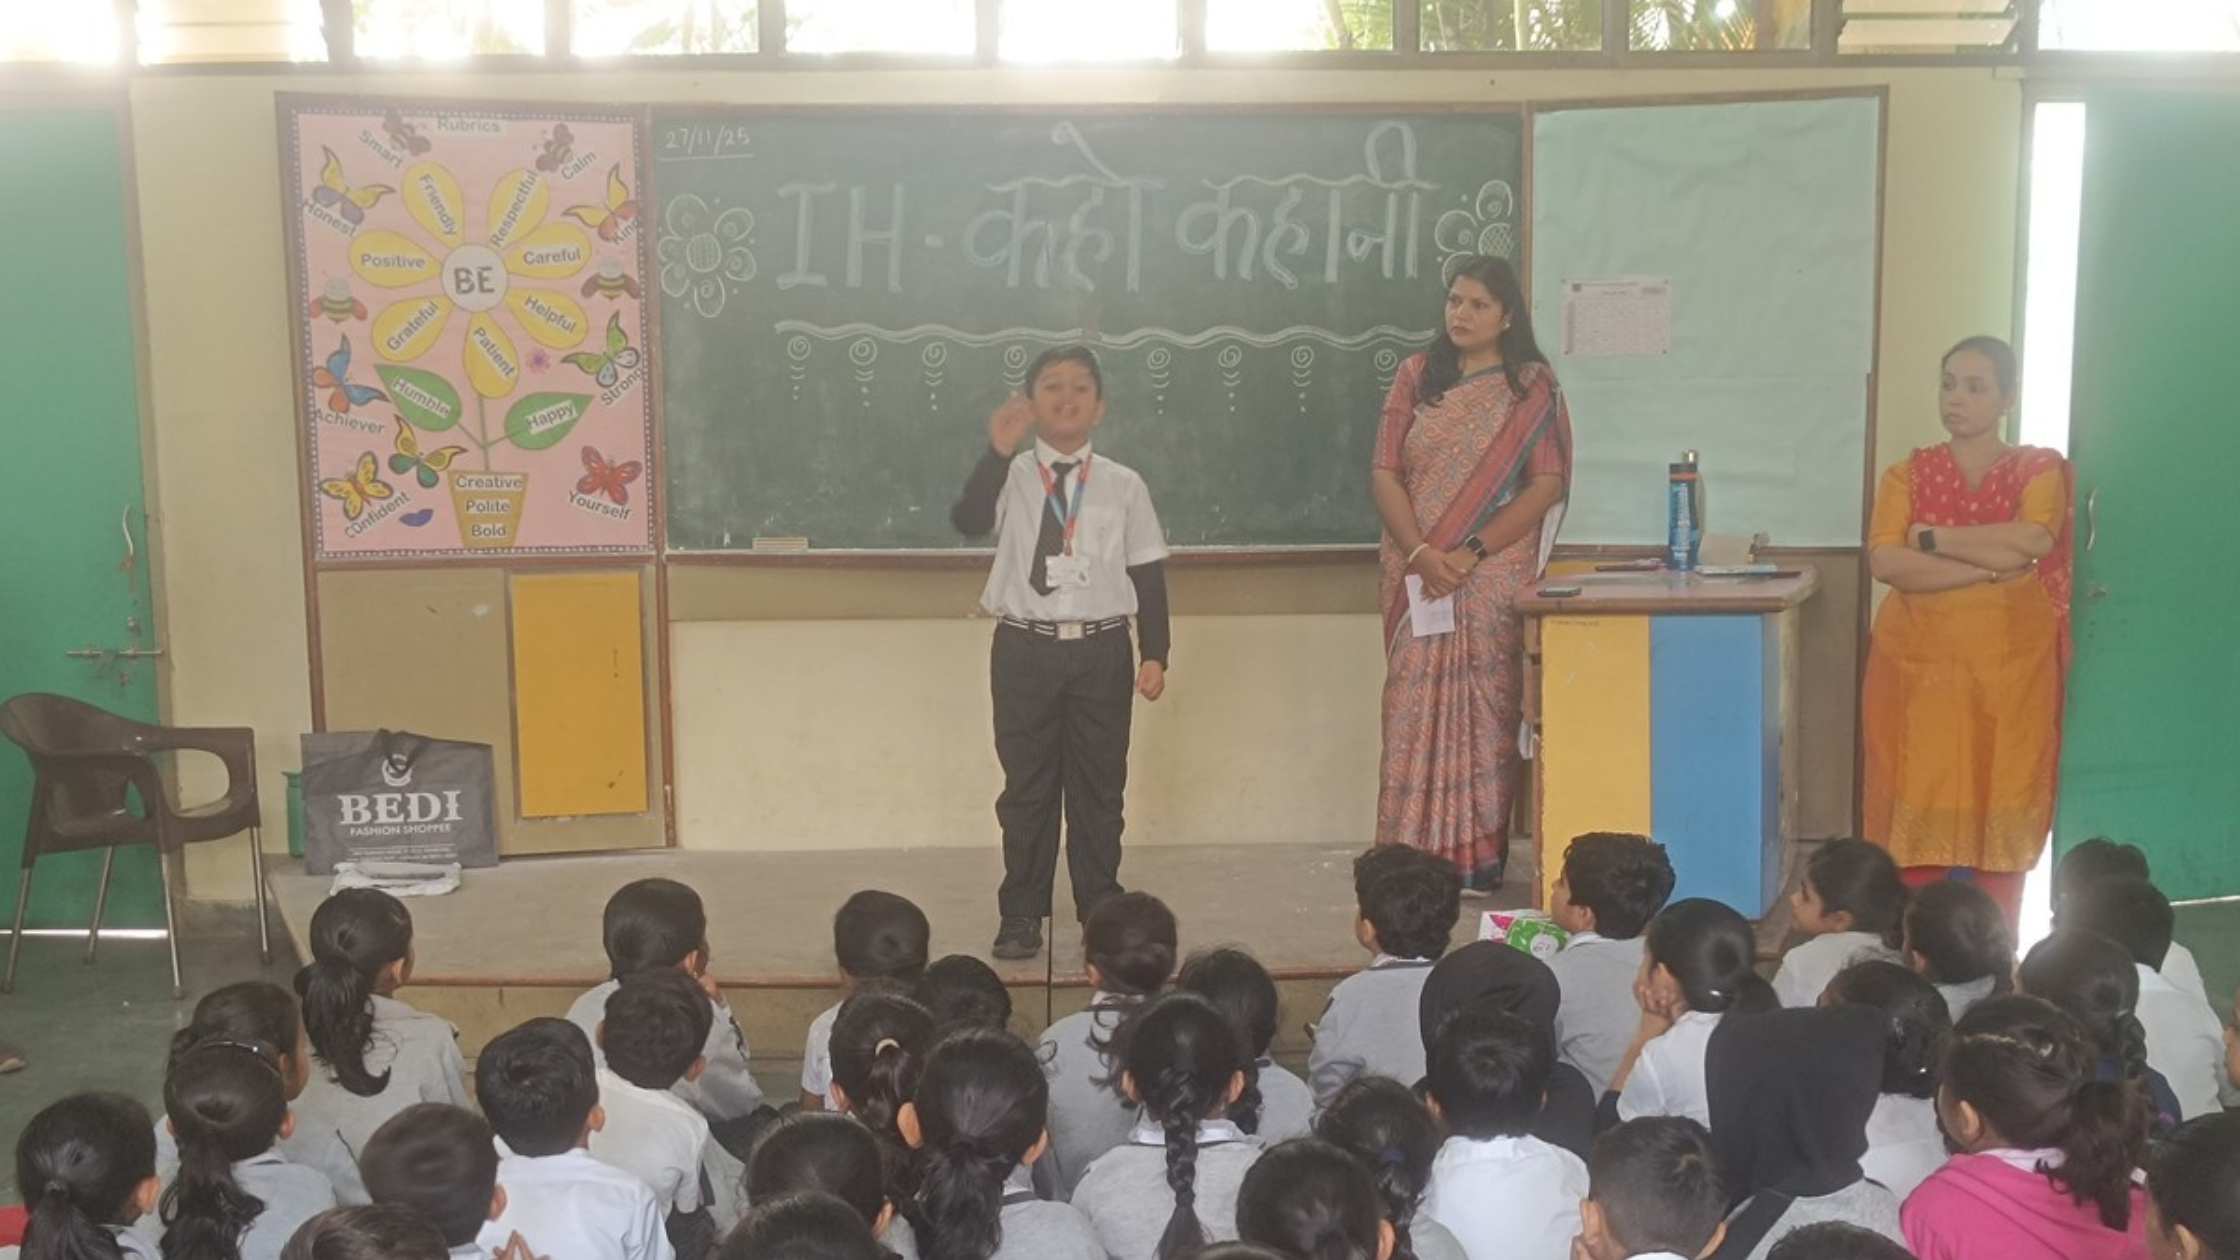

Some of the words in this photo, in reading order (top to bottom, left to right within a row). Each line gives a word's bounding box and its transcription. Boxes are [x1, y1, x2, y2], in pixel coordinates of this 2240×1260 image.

[436, 116, 501, 132] Rubrics
[358, 128, 403, 169] Smart
[664, 124, 751, 155] 27/11/25
[560, 151, 597, 180] Calm
[419, 172, 457, 236] Friendly
[490, 168, 539, 248] Respectful
[963, 120, 1168, 293] कहो
[1175, 119, 1441, 290] कहानी
[361, 253, 425, 269] Positive
[523, 247, 582, 265] Careful
[453, 265, 496, 295] BE
[386, 300, 440, 351] Grateful
[524, 294, 578, 333] Helpful
[472, 326, 517, 378] Patient
[392, 377, 450, 416] Humble
[314, 408, 386, 433] Achiever
[525, 404, 575, 429] Happy
[456, 474, 523, 488] Creative
[466, 499, 510, 513] Polite
[568, 490, 631, 520] Yourself
[471, 523, 507, 537] Bold
[336, 790, 464, 825] BEDI
[350, 825, 400, 837] FASHION
